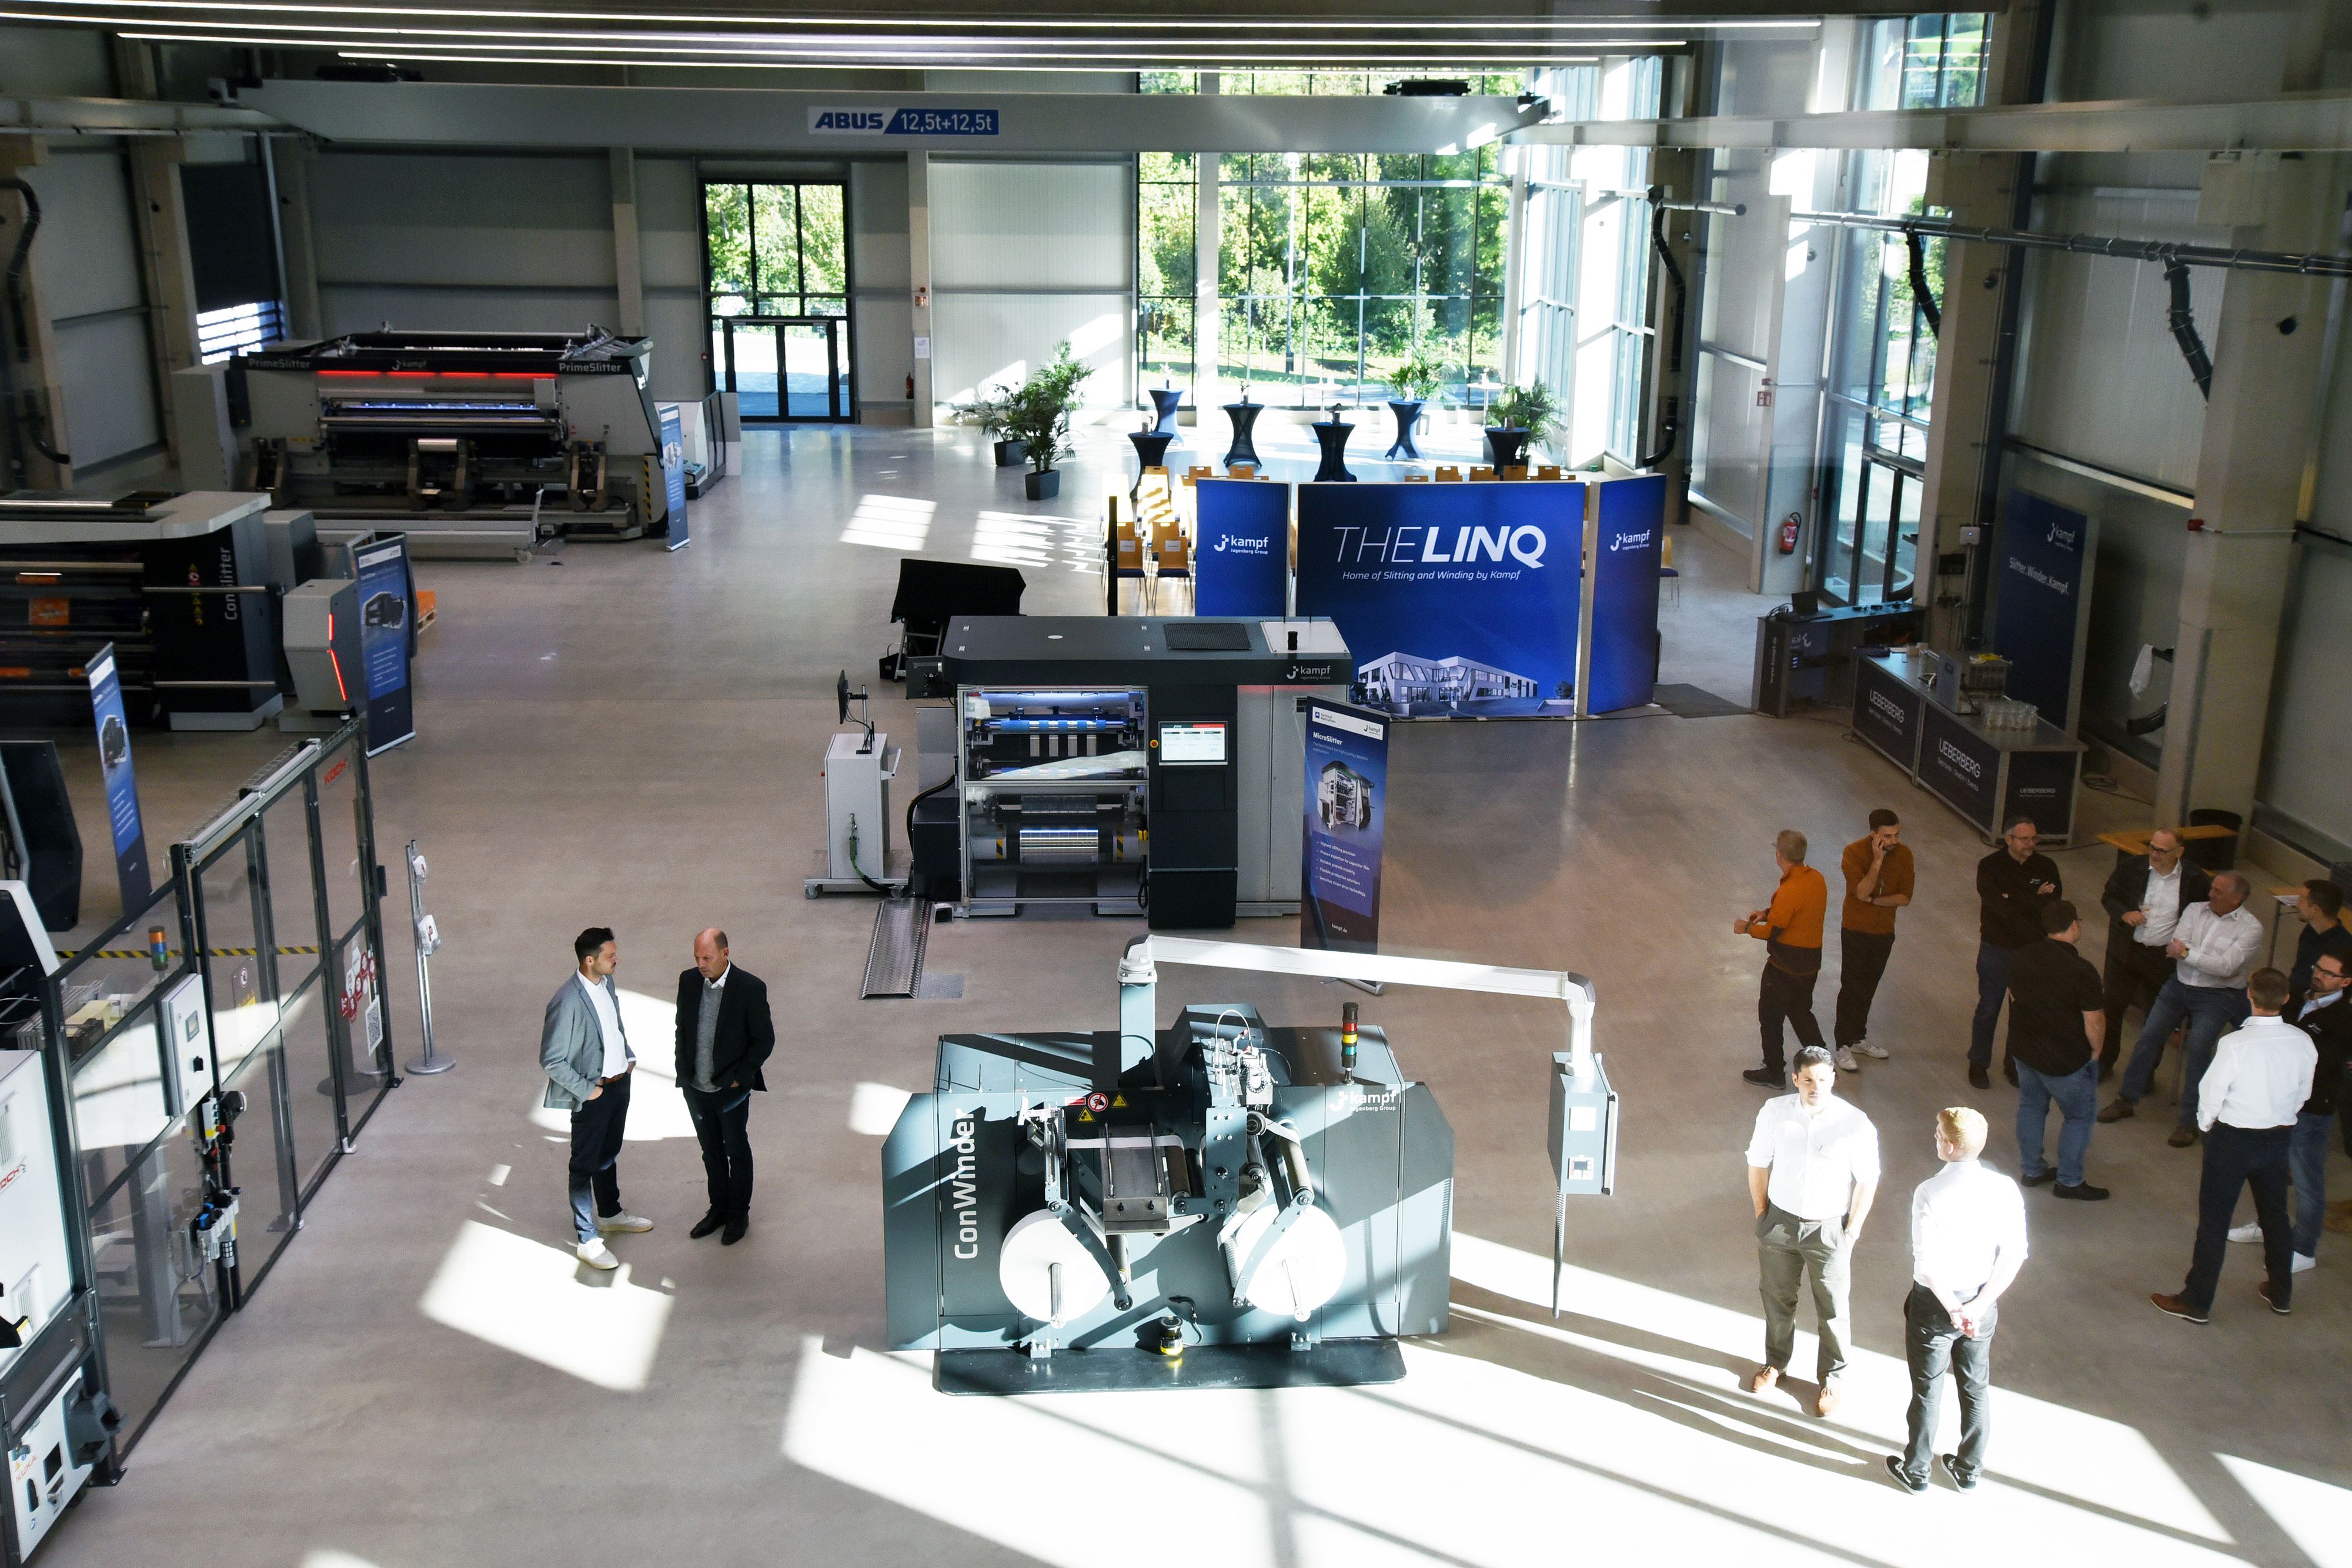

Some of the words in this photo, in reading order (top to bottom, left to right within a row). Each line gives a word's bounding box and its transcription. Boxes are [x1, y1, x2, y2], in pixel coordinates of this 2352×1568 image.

[815, 112, 883, 129] ABUS
[901, 113, 992, 133] 12,5t+12,5t
[248, 358, 311, 368] PrimeSlitter
[559, 363, 621, 372] PrimeSlitter
[1231, 534, 1269, 550] kampf
[1623, 529, 1651, 544] kampf
[219, 546, 238, 620] Conlitter
[1342, 571, 1369, 580] Home
[1371, 571, 1382, 581] of
[1383, 571, 1415, 581] Slitting
[1417, 571, 1435, 580] and
[1437, 571, 1474, 581] Winding
[1476, 571, 1488, 581] by
[1490, 570, 1521, 580] Kampf
[1300, 665, 1331, 676] kampf
[1870, 688, 1905, 723] UEBERBERG
[1313, 731, 1343, 745] MicroSlitter
[1939, 737, 1980, 778] UEBERBERG
[325, 758, 346, 785] KOCH
[1350, 1091, 1396, 1105] kampf
[949, 1108, 978, 1259] ConWinder
[15, 1455, 36, 1483] KUKA
